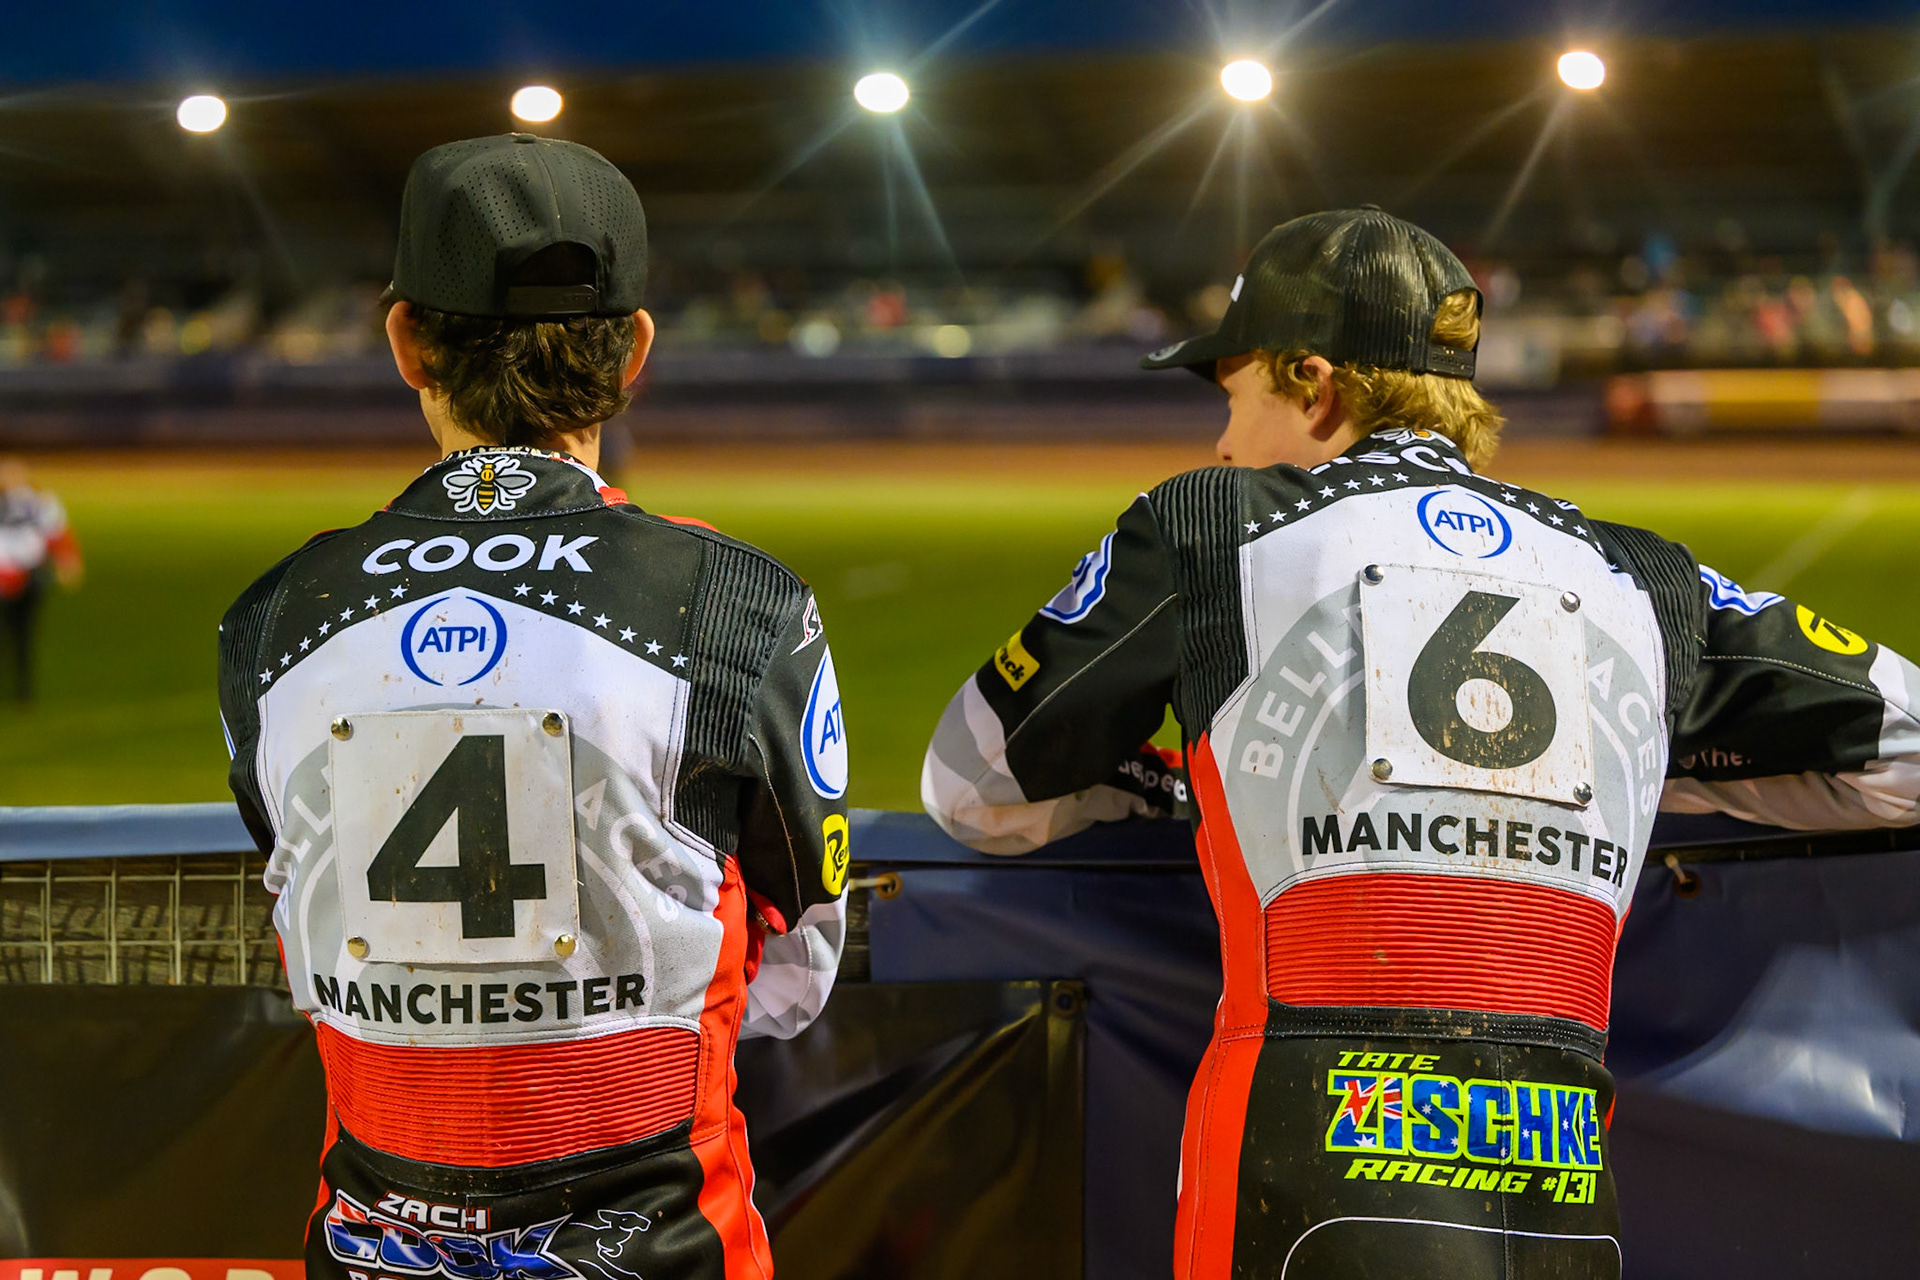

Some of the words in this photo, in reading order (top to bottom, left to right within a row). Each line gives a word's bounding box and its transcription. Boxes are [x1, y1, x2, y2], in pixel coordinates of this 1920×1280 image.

[1434, 509, 1495, 538] ATPI
[362, 534, 599, 575] COOK
[417, 626, 487, 654] ATPI
[1407, 590, 1557, 770] 6
[818, 696, 844, 755] AT
[1587, 657, 1658, 817] ACES
[366, 734, 547, 939] 4
[1302, 811, 1629, 889] MANCHESTER
[313, 973, 646, 1025] MANCHESTER
[1337, 1051, 1441, 1072] TATE
[1325, 1068, 1603, 1171] ZISCHKE
[1344, 1158, 1532, 1194] RACING
[1541, 1171, 1597, 1204] #131
[324, 1188, 588, 1280] COOK
[374, 1191, 489, 1231] ZACH
